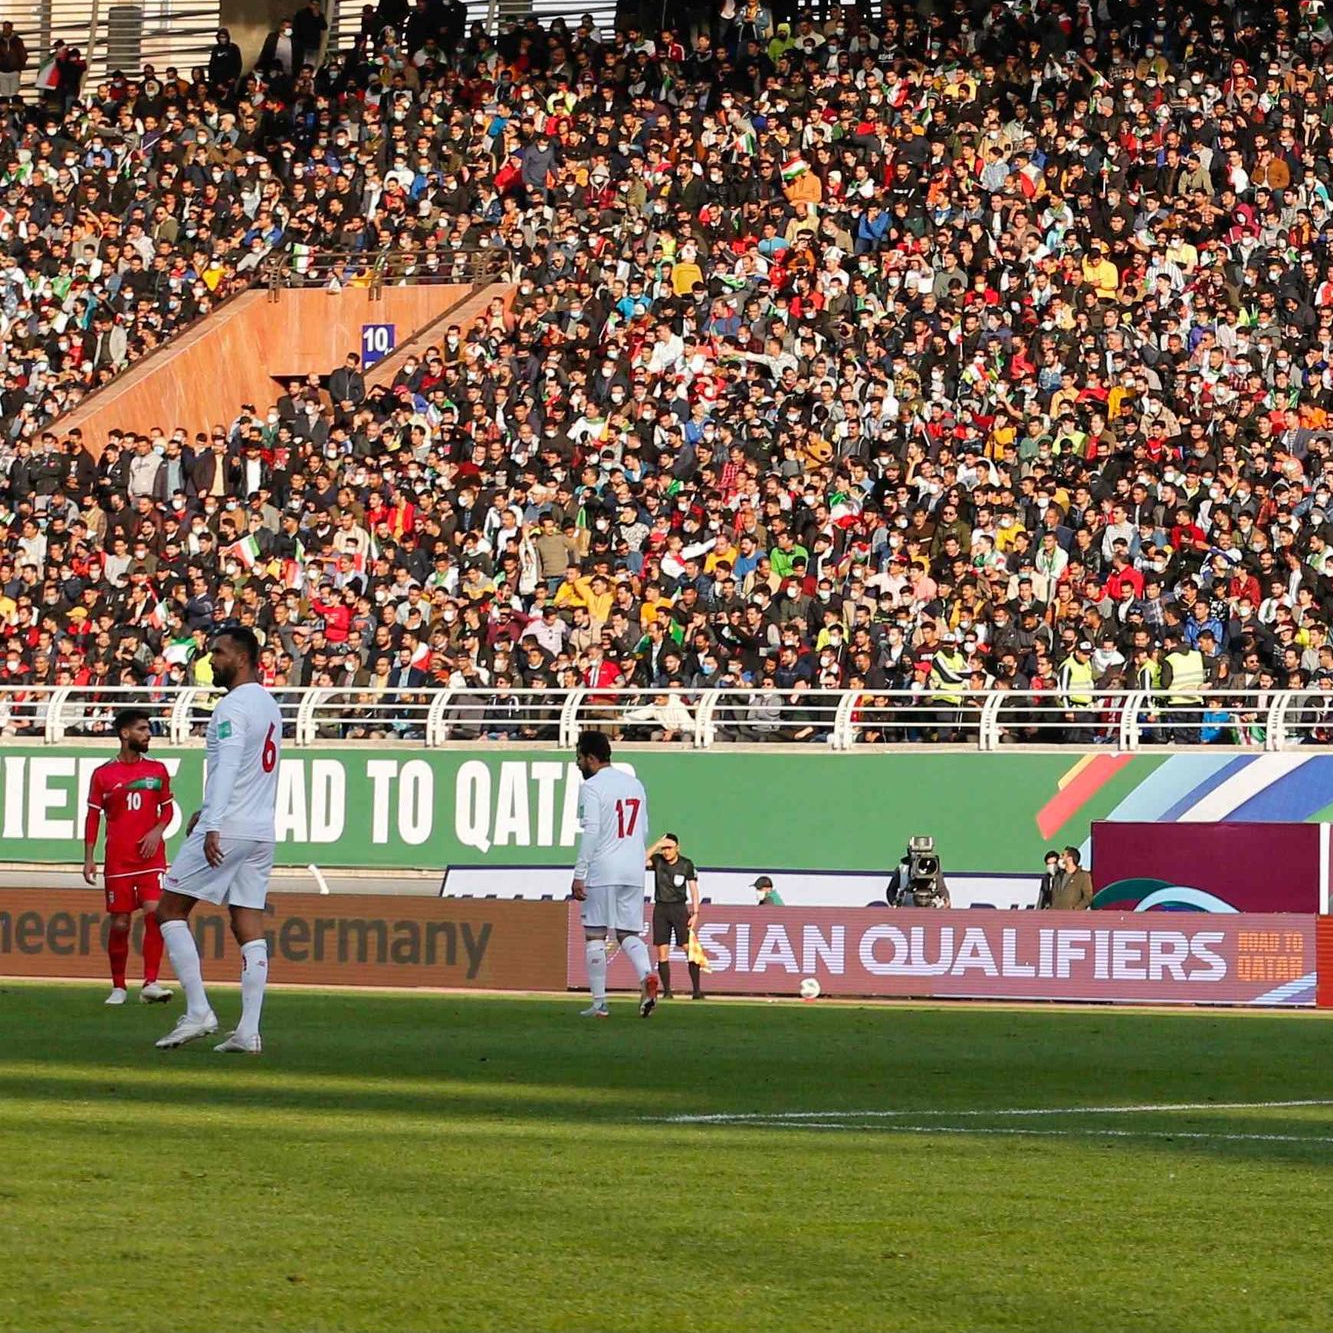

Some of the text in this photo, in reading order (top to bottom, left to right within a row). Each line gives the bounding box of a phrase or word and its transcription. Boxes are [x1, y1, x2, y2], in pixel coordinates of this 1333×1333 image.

[262, 721, 277, 774] 6
[126, 792, 142, 811] 10
[366, 759, 432, 845] TO
[455, 759, 637, 854] QATA
[615, 798, 642, 839] 17
[858, 923, 1226, 983] QUALIFIERS
[1238, 931, 1303, 953] ROAD TO
[1238, 956, 1303, 981] QATAR
